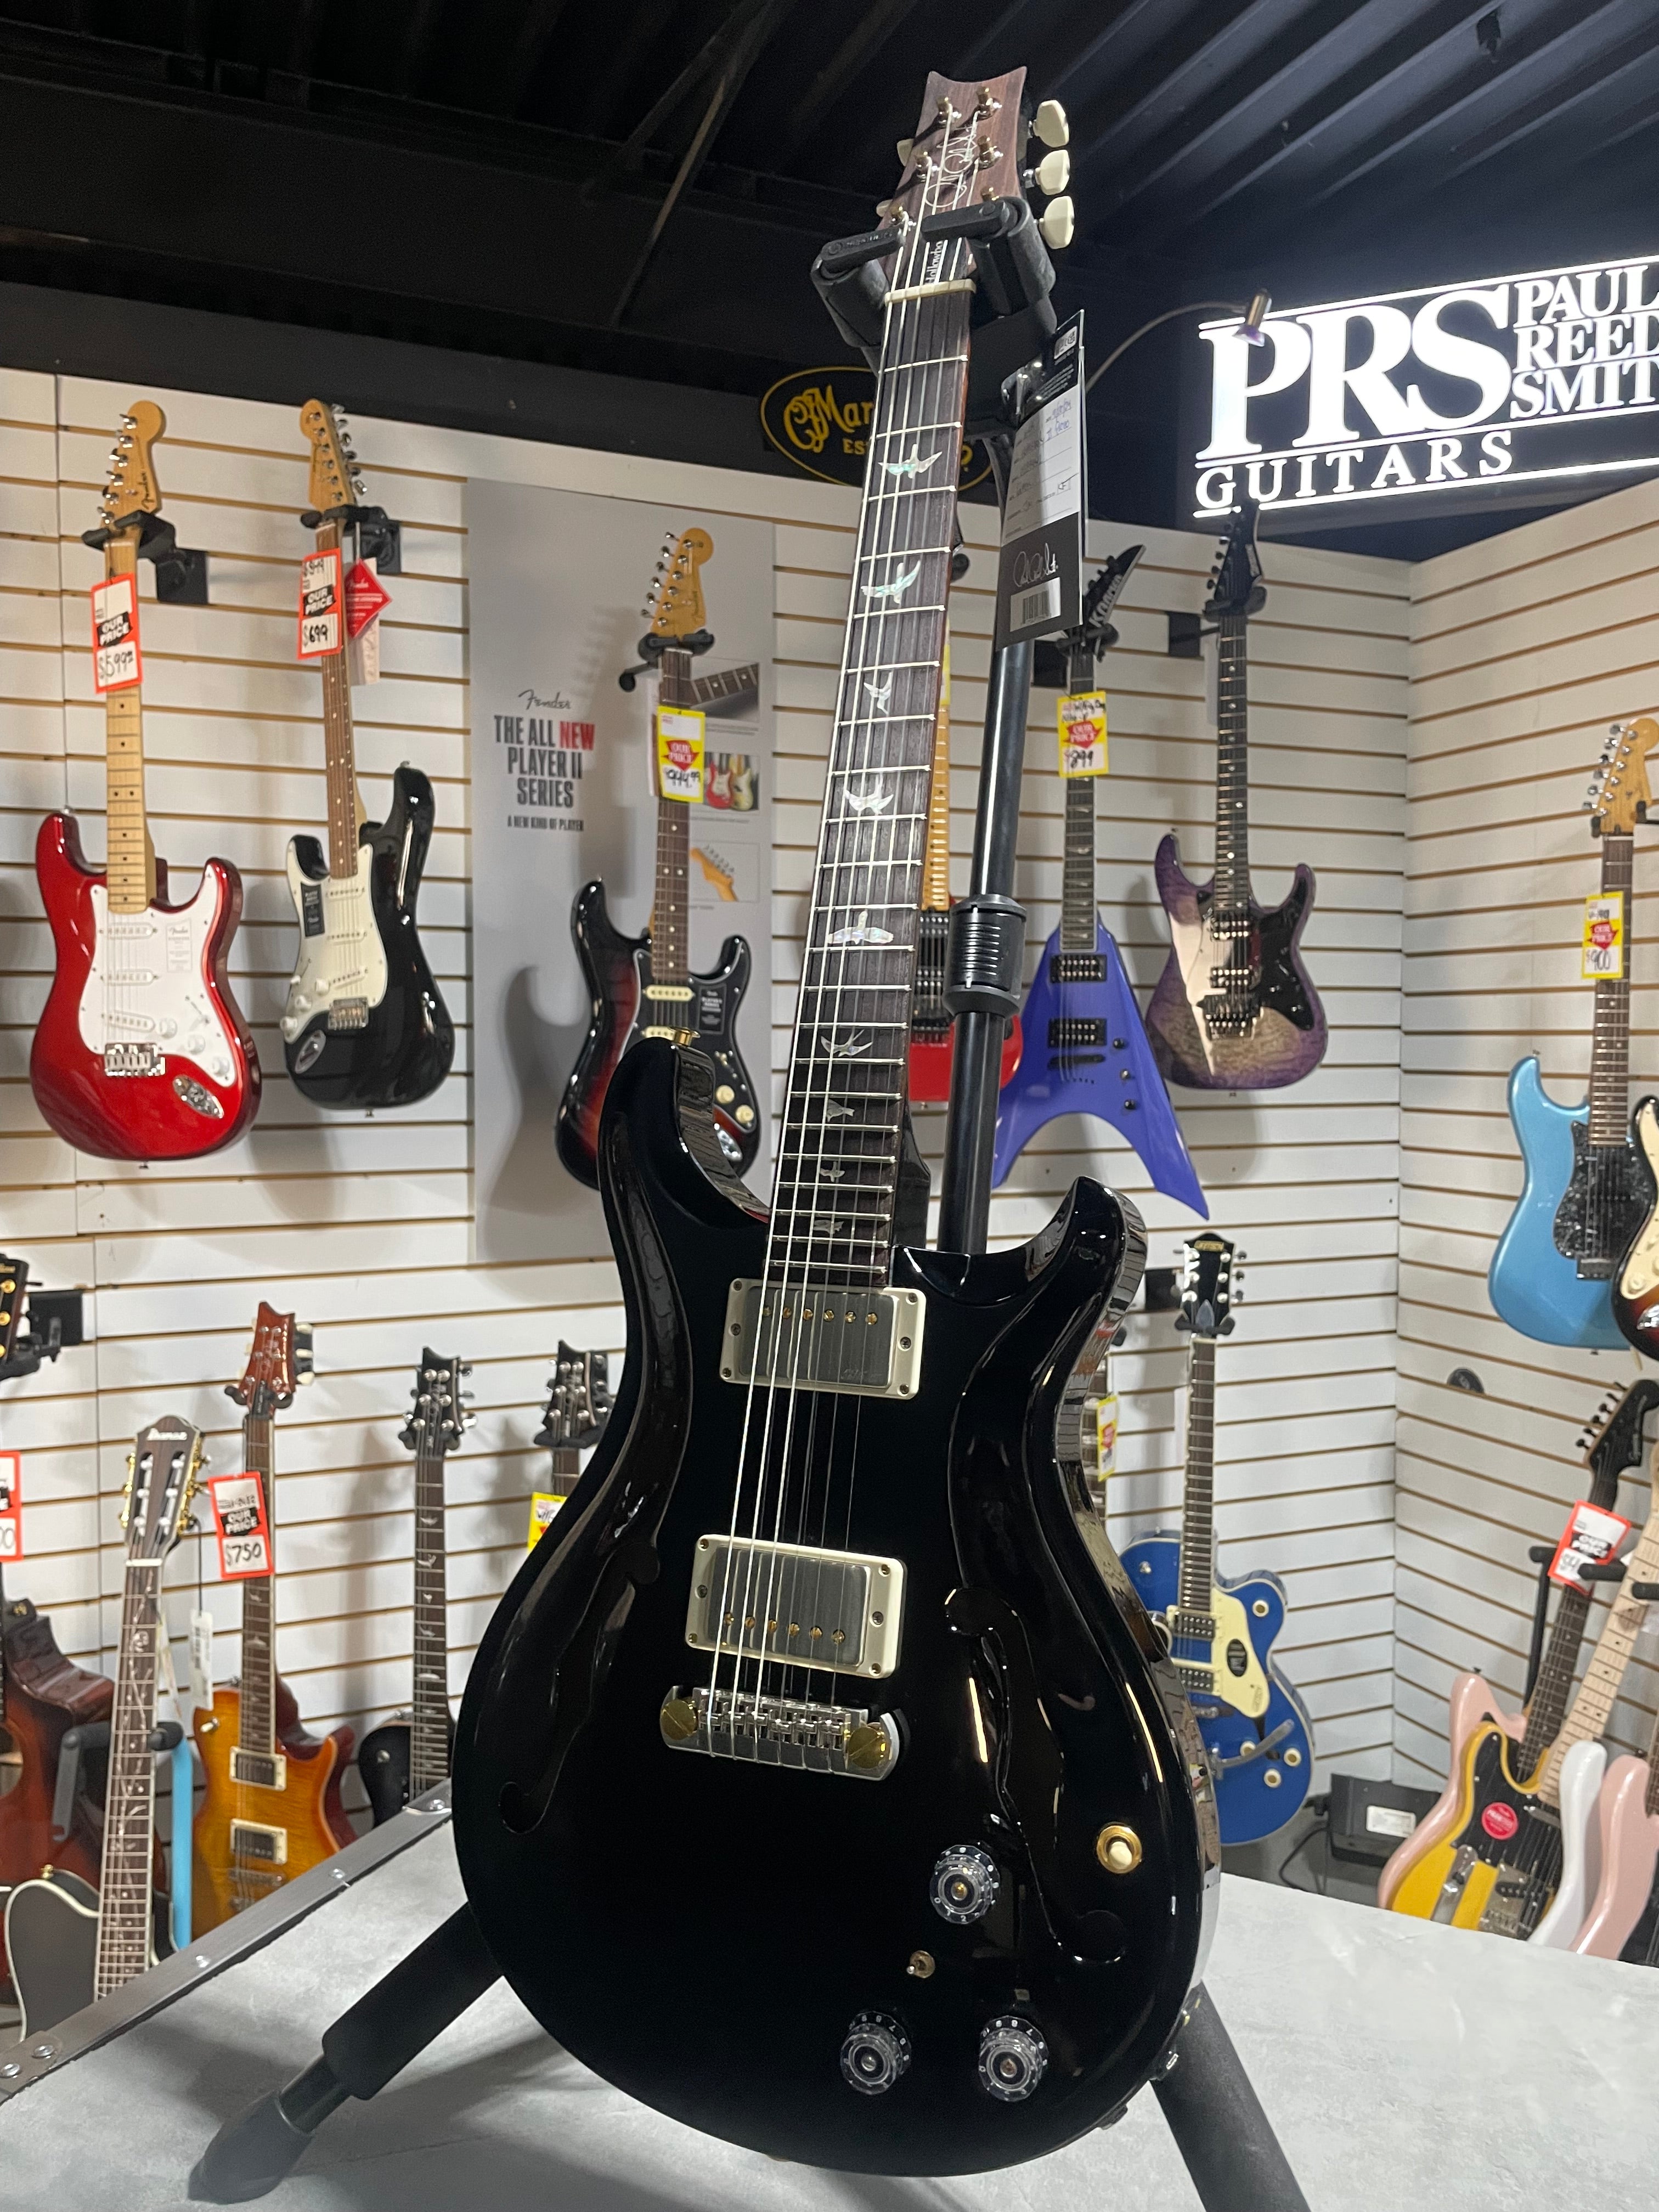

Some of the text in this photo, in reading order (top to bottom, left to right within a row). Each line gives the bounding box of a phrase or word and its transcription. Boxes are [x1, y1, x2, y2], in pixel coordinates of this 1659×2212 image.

[923, 240, 944, 284] Hollowbo
[1513, 265, 1659, 329] PAUL
[1195, 284, 1512, 460] PRS
[1510, 357, 1659, 419] SMIT
[843, 438, 871, 455] ES
[1195, 430, 1513, 509] GUITARS
[517, 689, 572, 710] Fender
[494, 715, 595, 751] THE ALL NEW
[507, 747, 583, 780] PLAYER II
[517, 777, 574, 809] SERIES
[507, 815, 512, 827] A
[559, 819, 584, 832] PLAYER
[225, 1542, 262, 1566] $750
